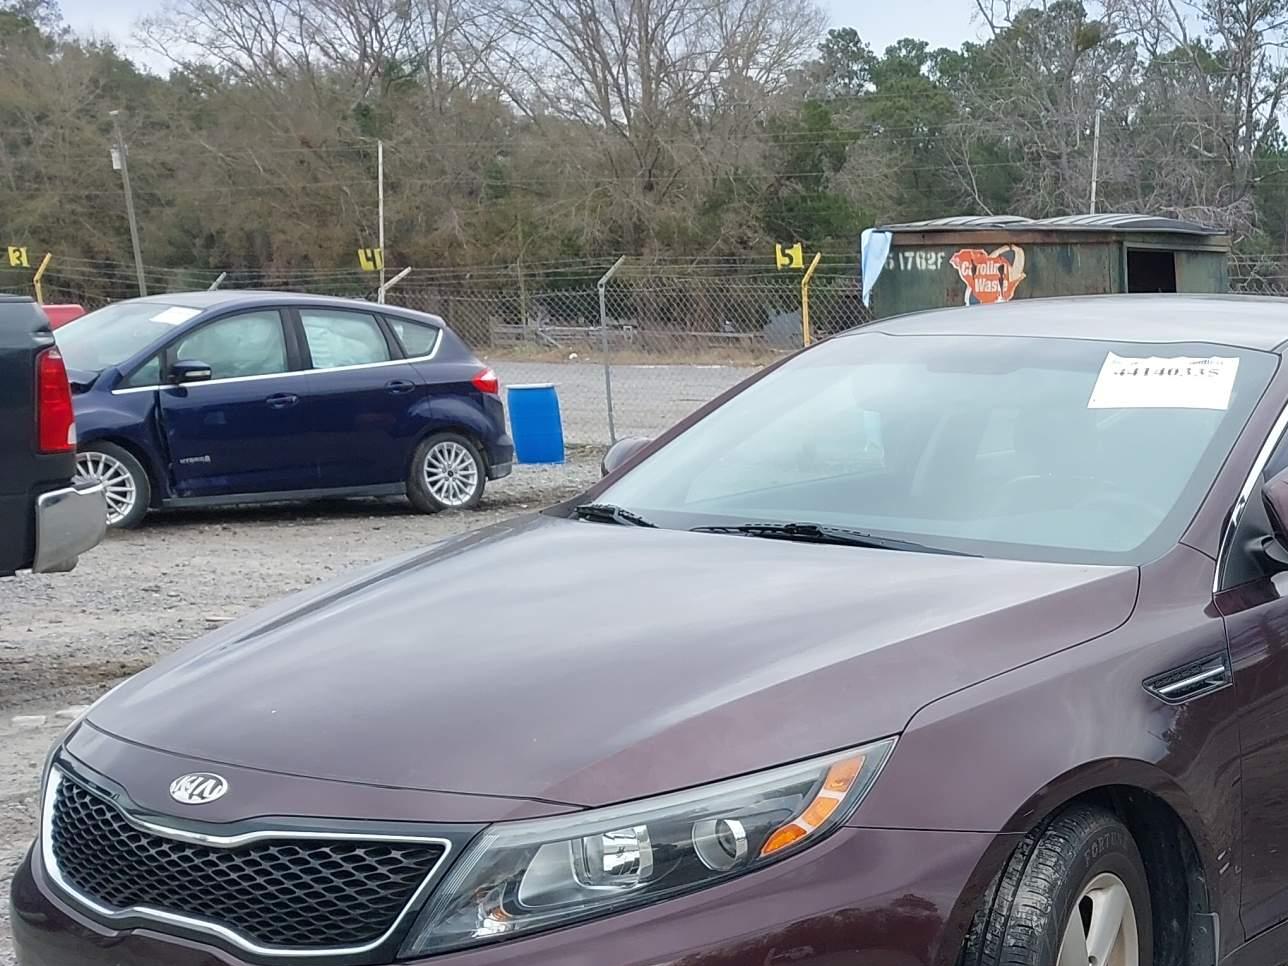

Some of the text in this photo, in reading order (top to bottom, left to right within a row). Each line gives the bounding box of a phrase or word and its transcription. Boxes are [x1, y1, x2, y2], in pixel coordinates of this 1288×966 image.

[12, 249, 23, 267] 3
[363, 248, 377, 270] 4
[780, 243, 793, 267] 5
[171, 774, 225, 802] KIA
